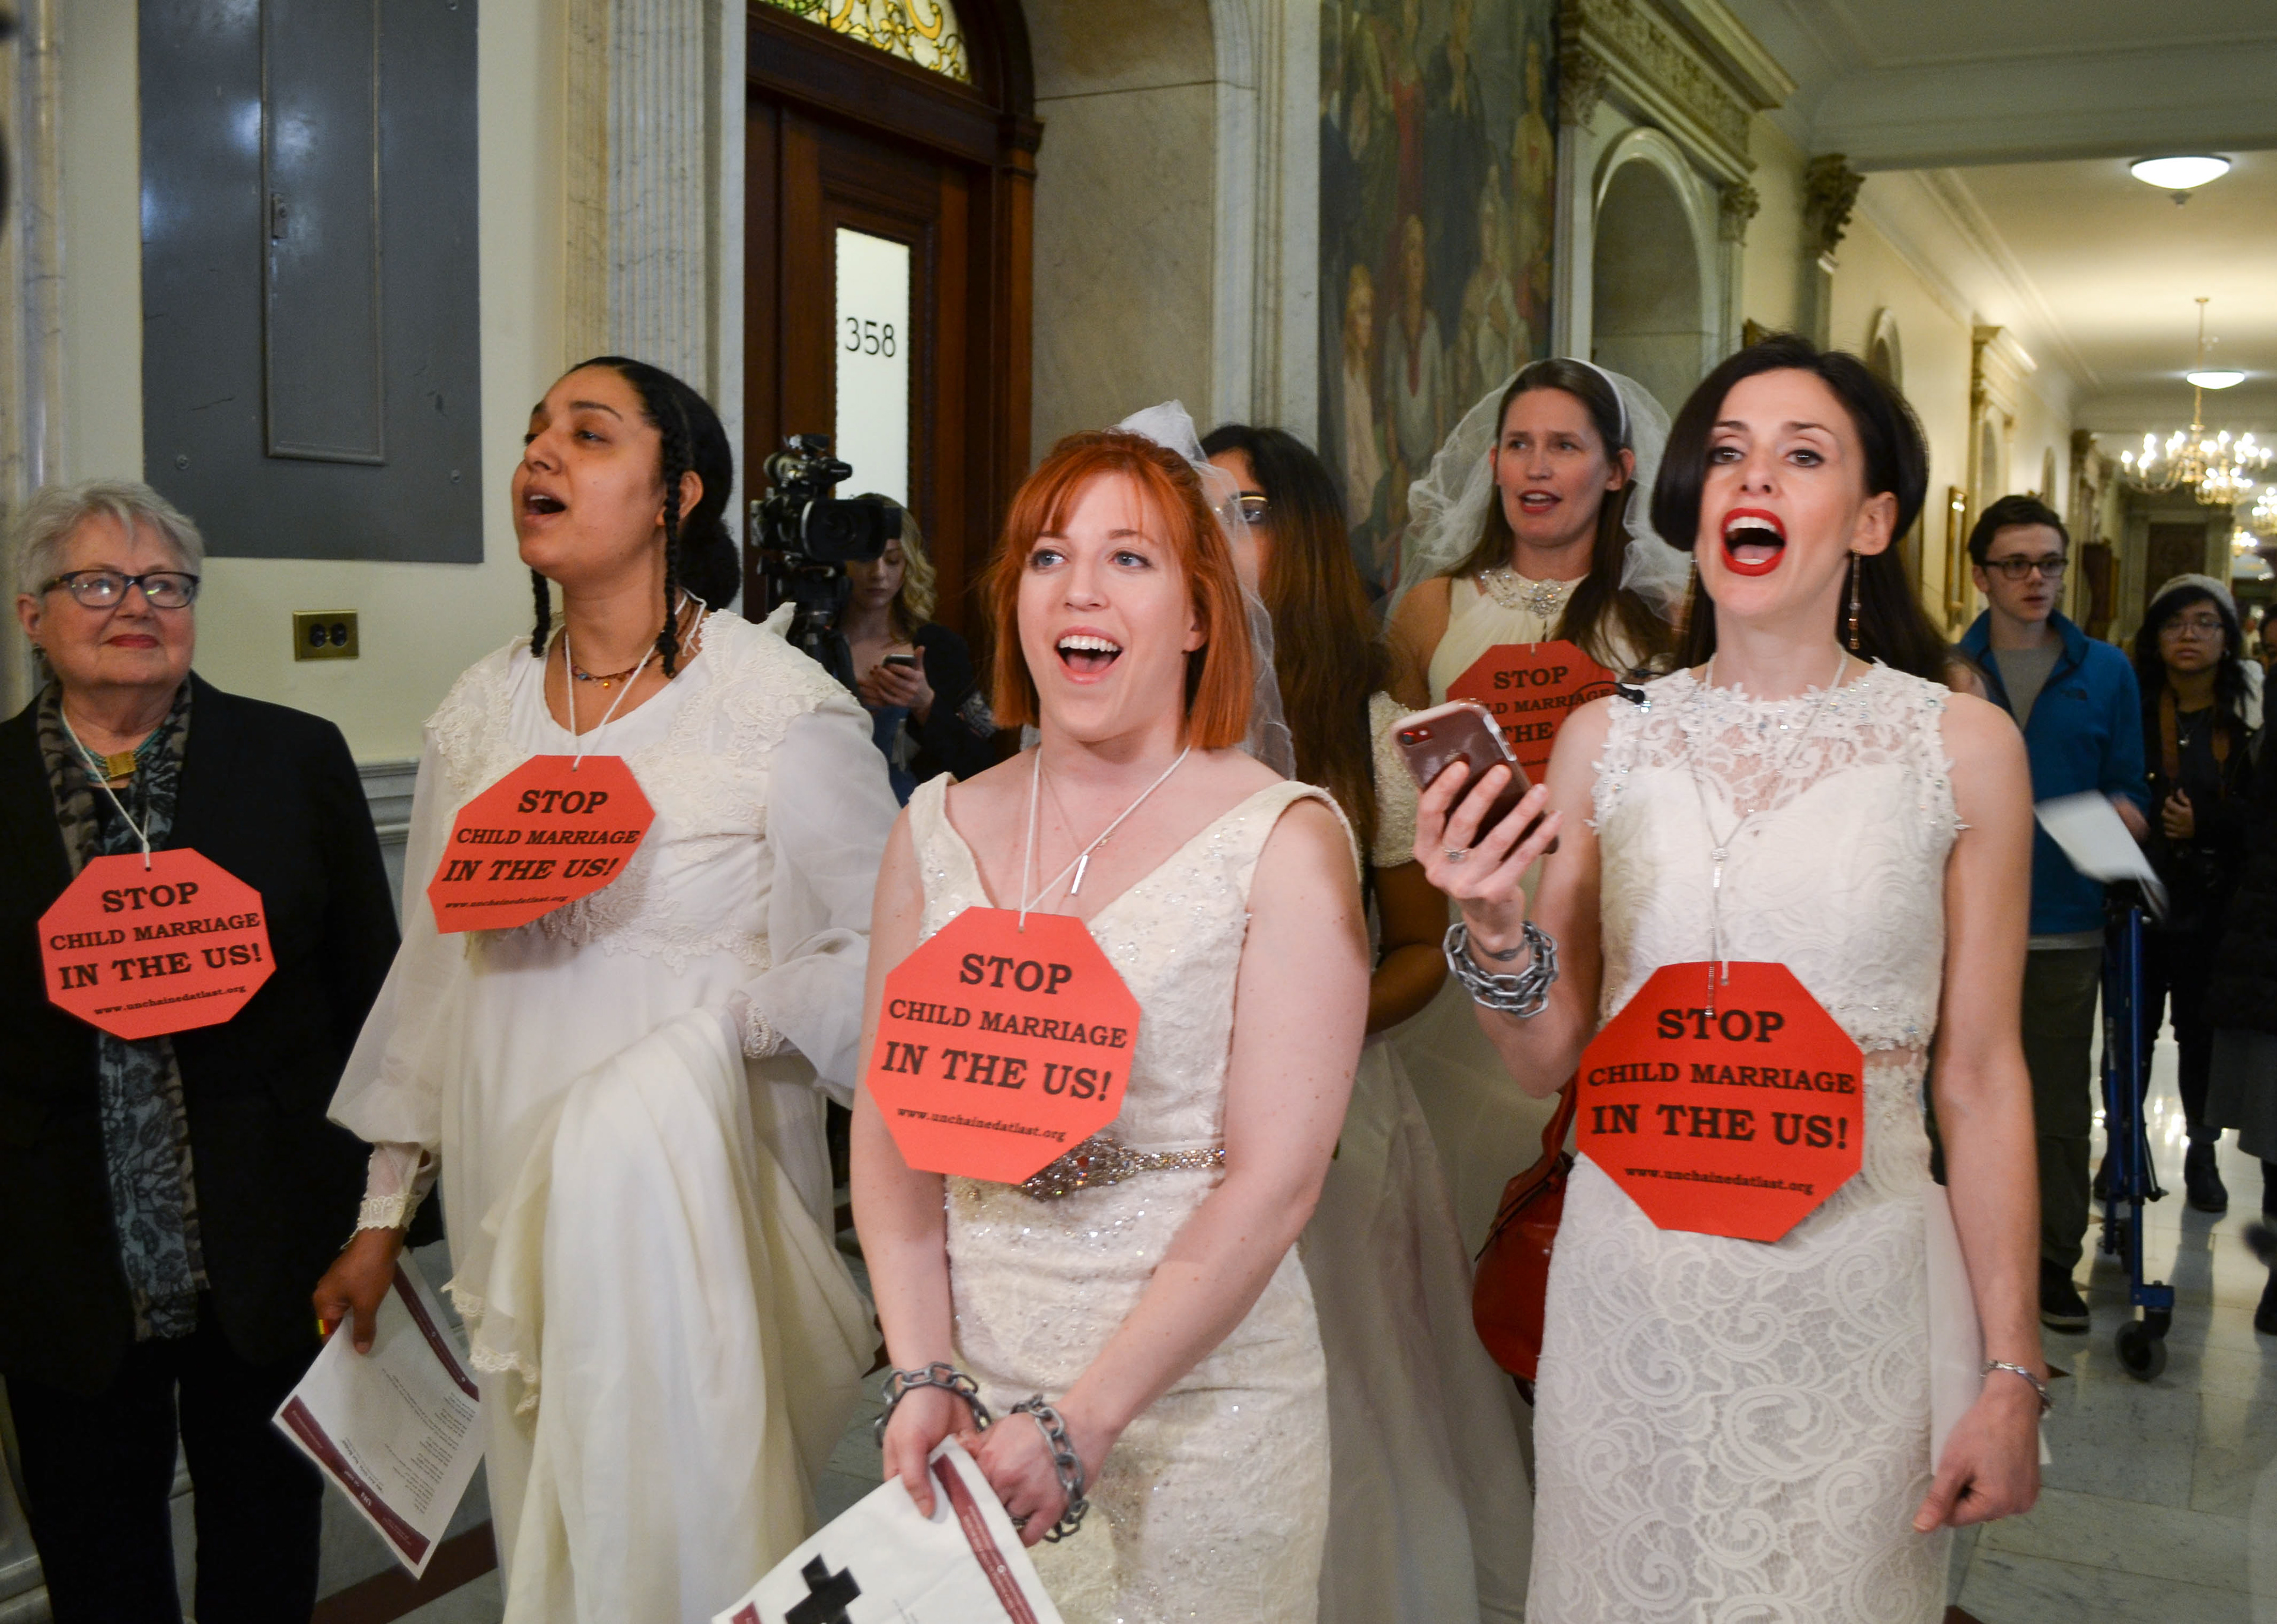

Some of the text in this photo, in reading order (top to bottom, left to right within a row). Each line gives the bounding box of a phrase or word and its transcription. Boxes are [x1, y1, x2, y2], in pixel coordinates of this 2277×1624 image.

[845, 317, 896, 358] 358
[1494, 666, 1568, 690] STOP
[518, 789, 608, 814] STOP
[457, 828, 640, 845] CHILD MARRIAGE
[442, 857, 619, 882] IN THE US!
[101, 882, 199, 913] STOP
[50, 912, 260, 951] CHILD MARRIAGE
[59, 943, 263, 990] IN THE US!
[960, 953, 1072, 994] STOP
[889, 998, 1128, 1048] CHILD MARRIAGE
[1657, 1008, 1785, 1043] STOP
[881, 1041, 1112, 1102] IN THE US!
[1587, 1063, 1856, 1095] CHILD MARRIAGE
[897, 1108, 1067, 1143] www.unchainedatlast.org
[1592, 1103, 1848, 1150] IN THE US!
